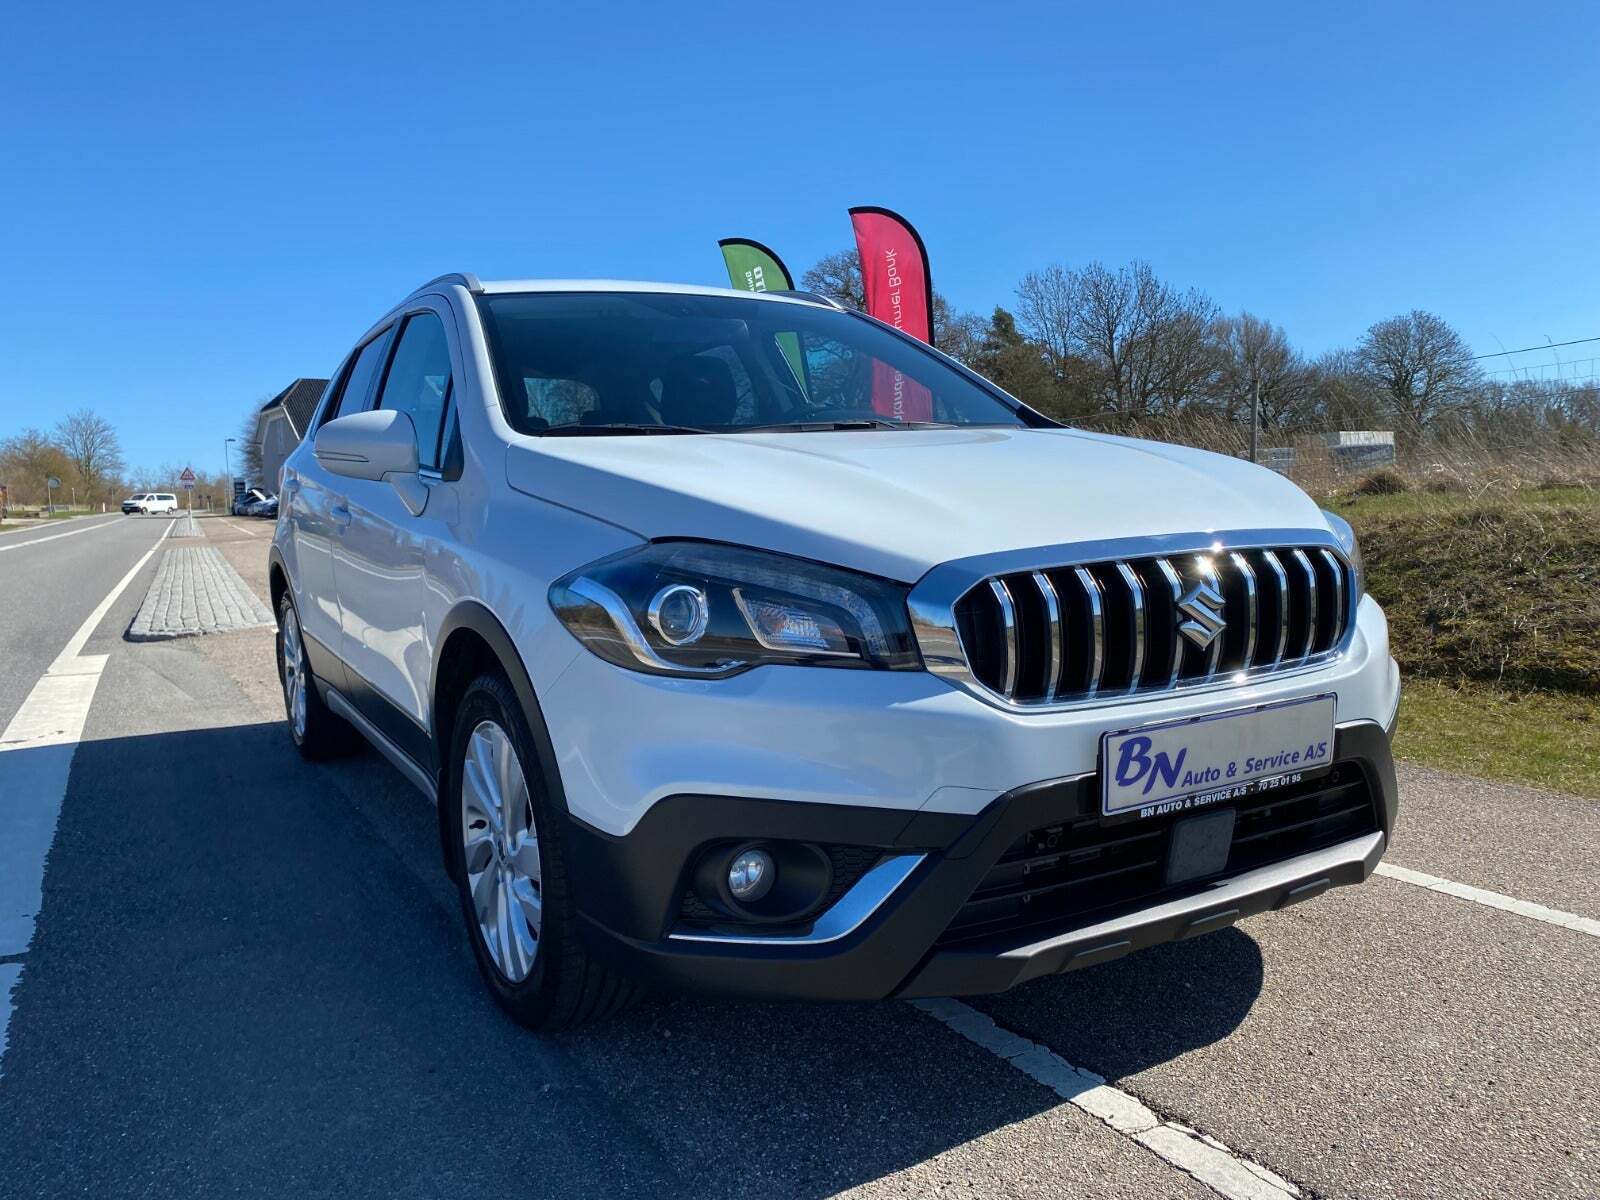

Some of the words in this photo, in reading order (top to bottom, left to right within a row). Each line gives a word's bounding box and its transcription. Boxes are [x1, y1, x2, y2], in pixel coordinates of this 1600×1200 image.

[1115, 736, 1187, 795] BN
[1181, 766, 1220, 788] Auto
[1226, 761, 1237, 778] &
[1245, 750, 1300, 774] Service
[1304, 742, 1328, 761] A/S
[1140, 807, 1155, 818] BN
[1156, 801, 1182, 815] AUTO
[1184, 799, 1191, 808] &
[1194, 789, 1232, 806] SERVICE
[1233, 786, 1247, 797] A/S
[1258, 782, 1268, 792] 70
[1269, 779, 1279, 789] 25
[1281, 775, 1290, 785] 01
[1291, 773, 1302, 783] 95
